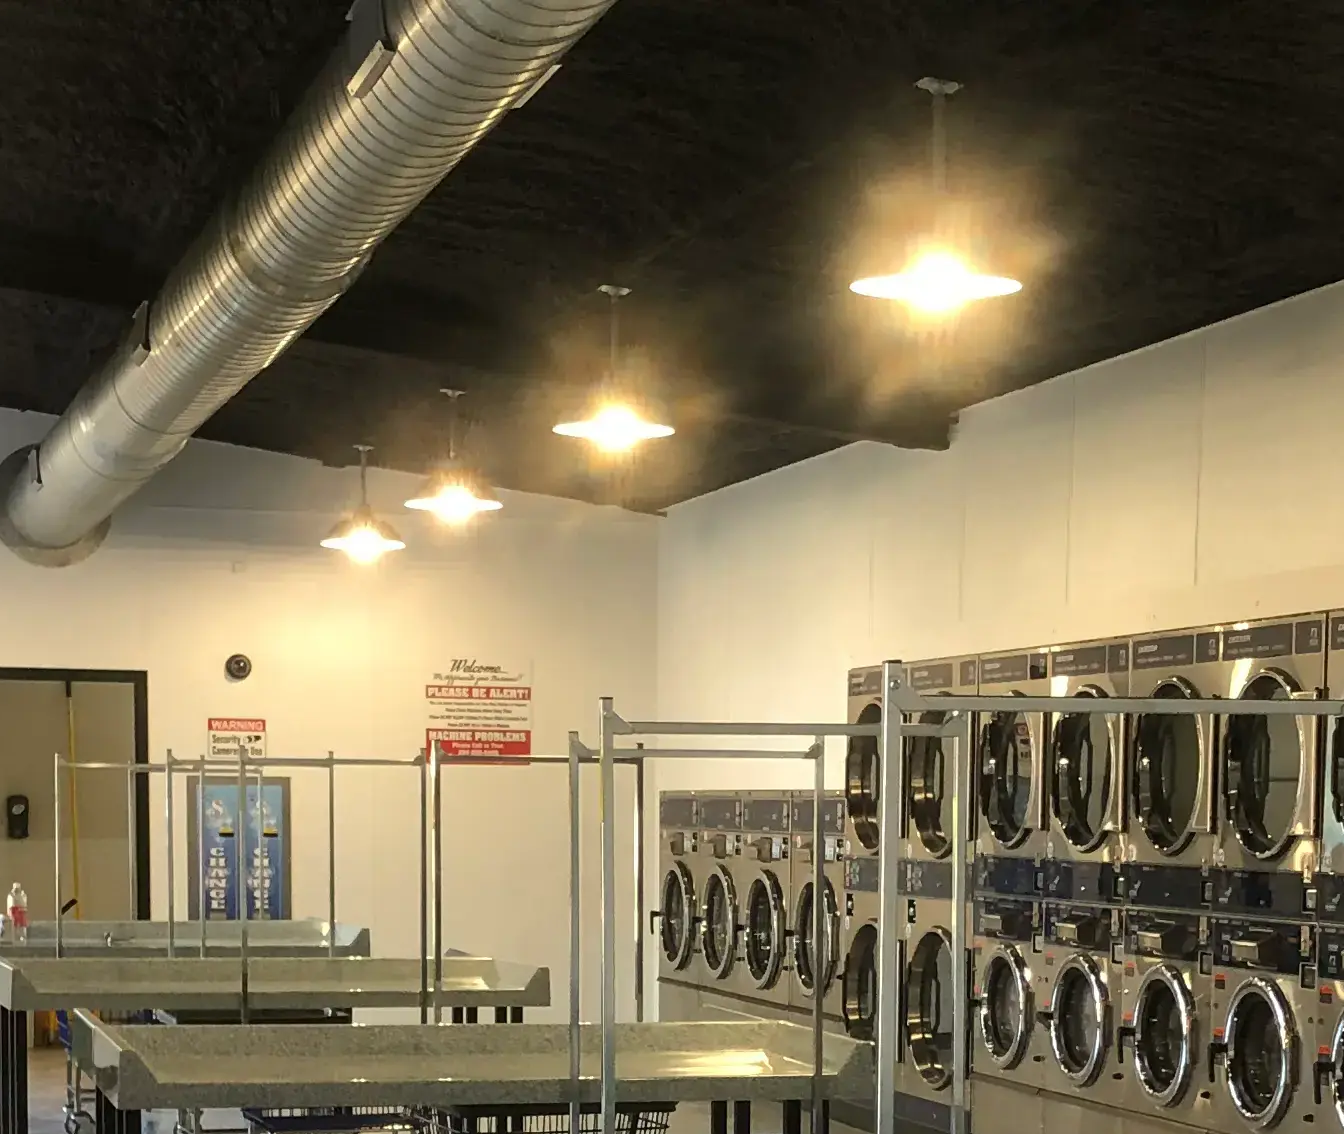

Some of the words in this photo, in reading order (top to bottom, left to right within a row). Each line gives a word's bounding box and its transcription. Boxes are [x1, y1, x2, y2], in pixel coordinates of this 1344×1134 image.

[450, 659, 505, 674] Welcome
[427, 687, 470, 698] PLEASE
[471, 687, 487, 698] BE
[489, 688, 529, 699] ALERT!
[211, 720, 263, 731] WARNING
[212, 734, 241, 746] Security
[429, 731, 472, 741] MACHINE
[474, 732, 526, 743] PROBLEMS
[209, 847, 227, 909] CHANGE
